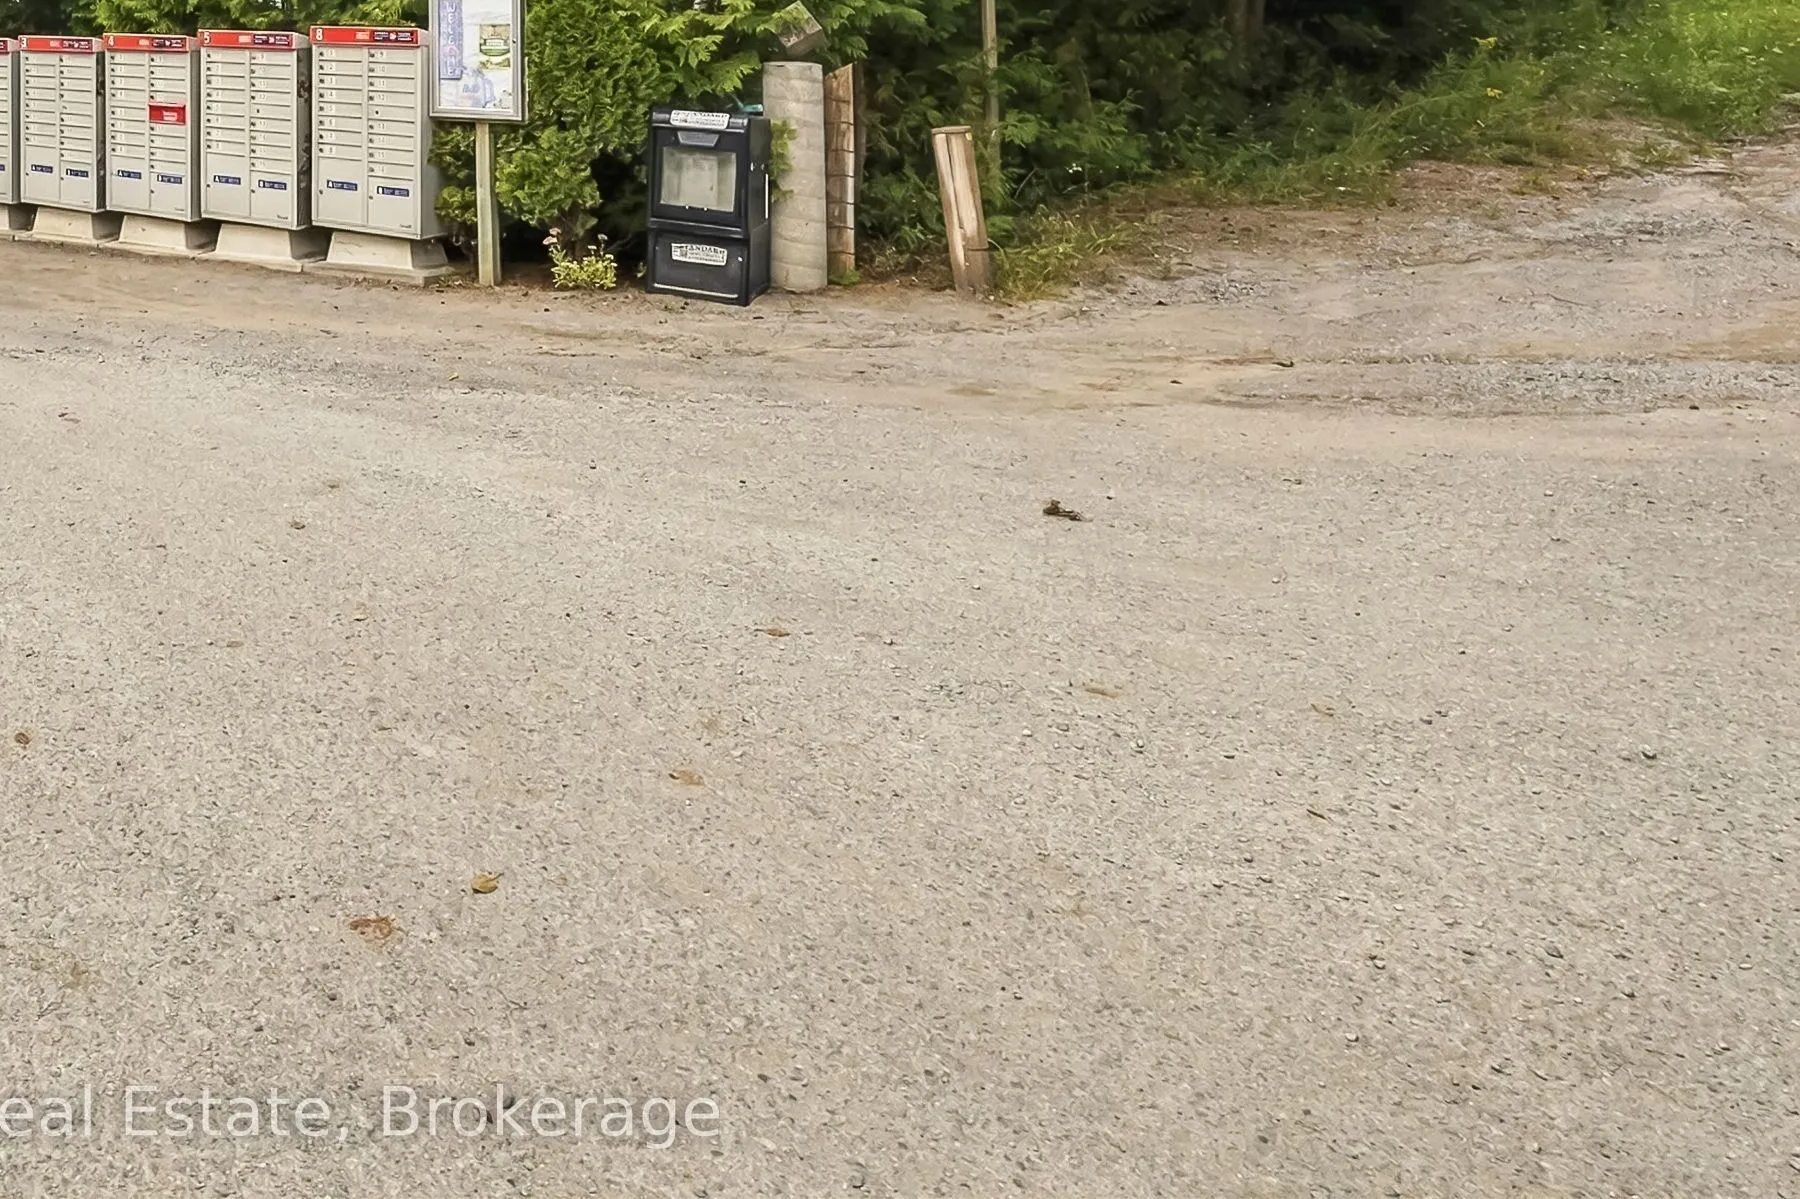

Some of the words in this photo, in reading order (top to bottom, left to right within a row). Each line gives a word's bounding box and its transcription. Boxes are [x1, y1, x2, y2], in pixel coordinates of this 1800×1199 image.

[107, 35, 114, 46] 4
[203, 31, 211, 44] 5
[315, 28, 323, 41] 8
[20, 37, 27, 48] 3
